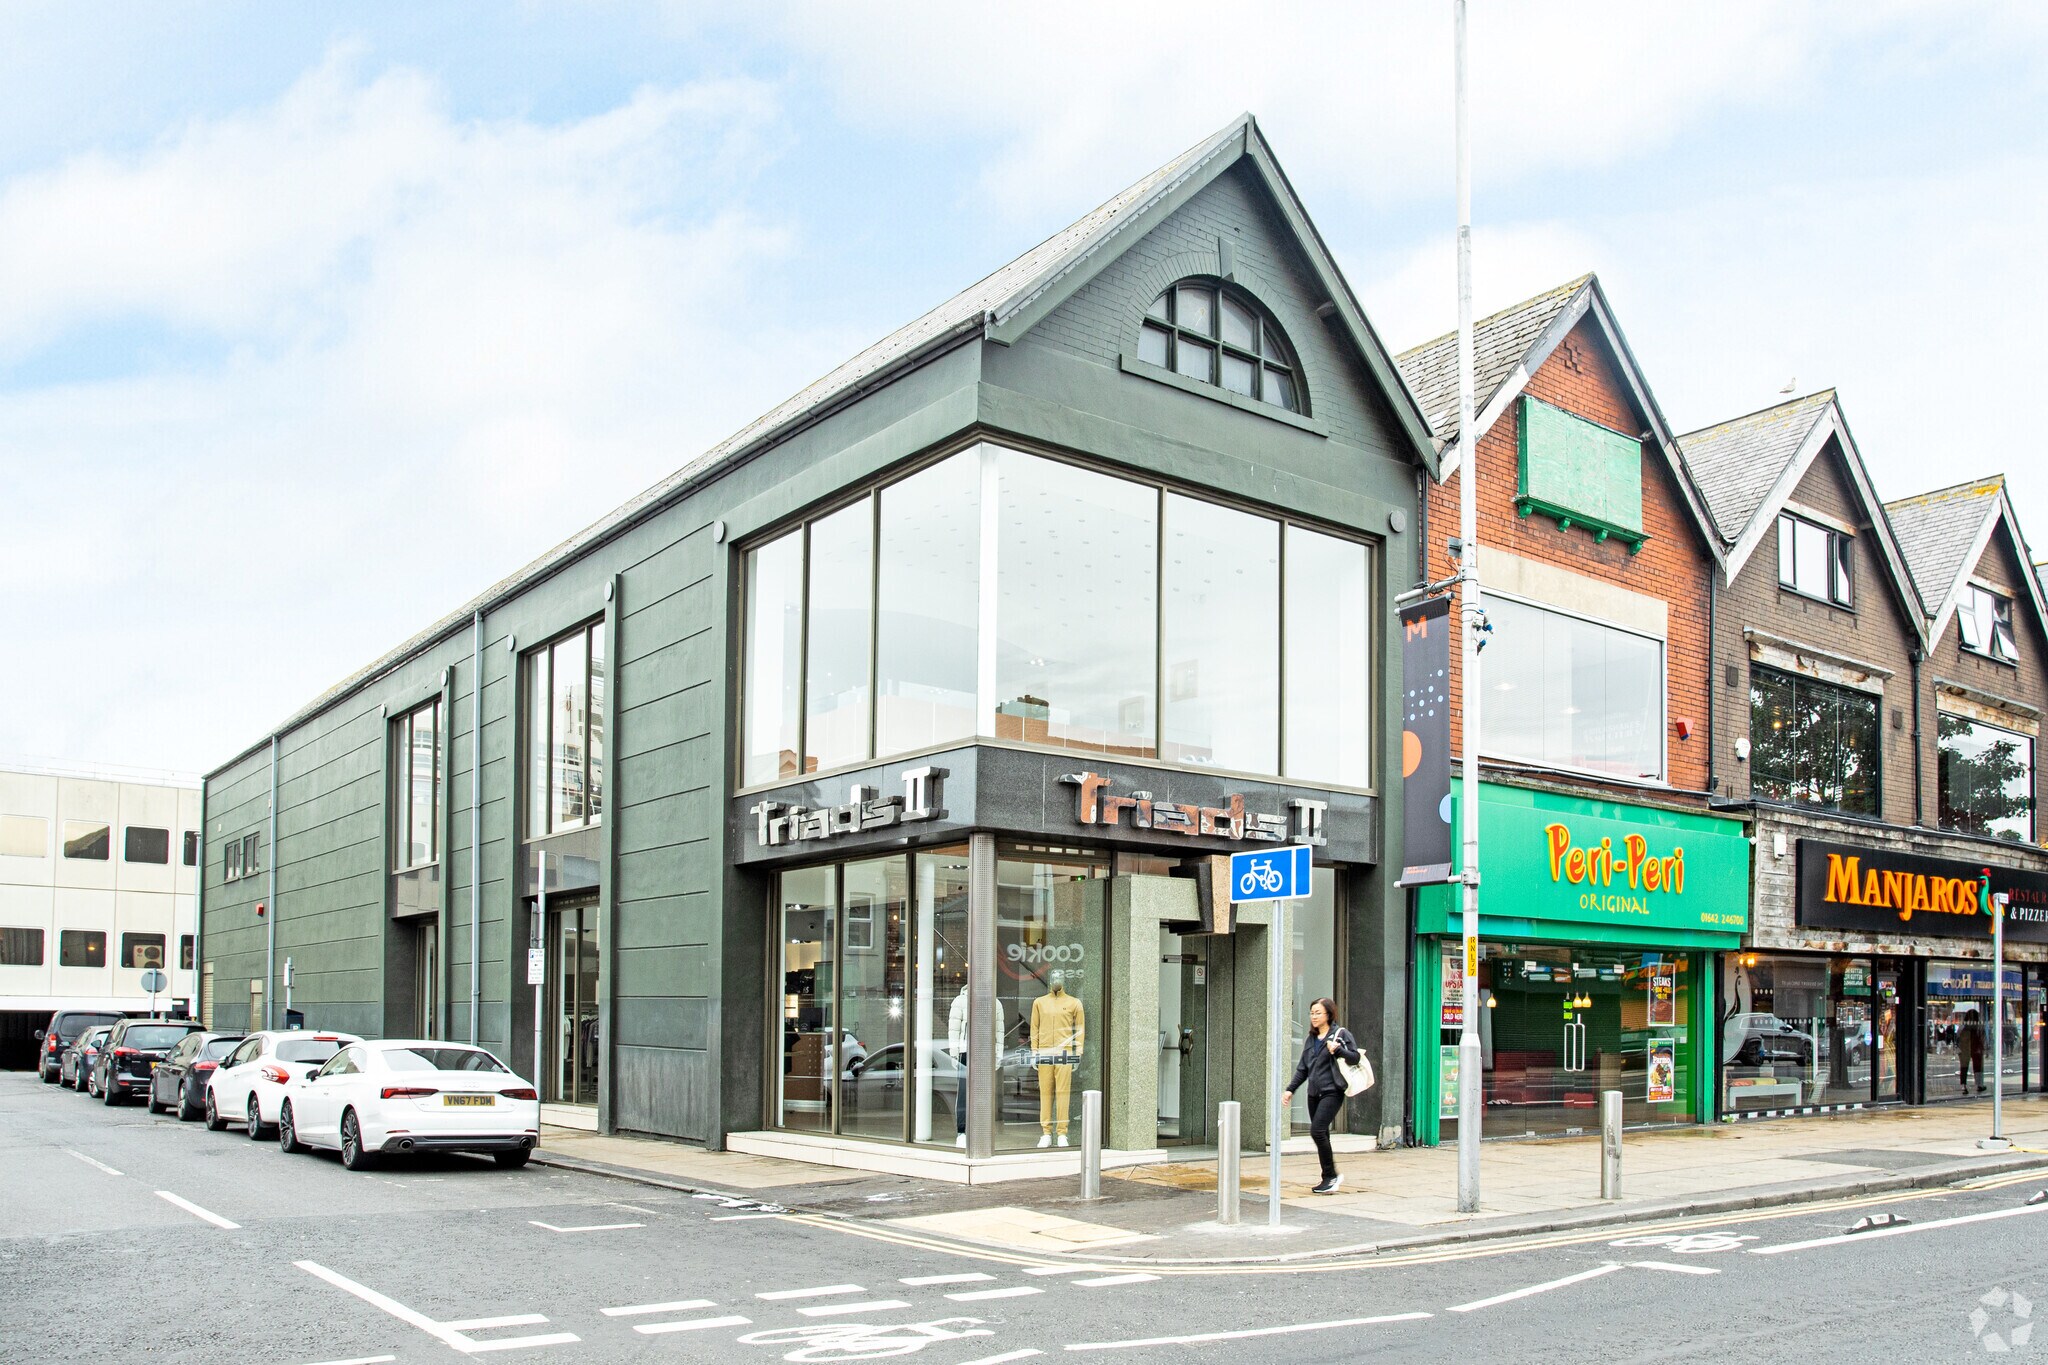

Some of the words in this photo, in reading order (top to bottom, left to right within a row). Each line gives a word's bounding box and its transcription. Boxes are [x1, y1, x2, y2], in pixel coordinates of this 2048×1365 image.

[1406, 614, 1428, 642] M
[750, 783, 902, 846] Triads
[900, 765, 950, 822] II
[1058, 771, 1288, 841] Triads
[1288, 798, 1328, 847] II
[1544, 823, 1685, 895] Peri-Peri
[1824, 853, 1978, 922] MANJAROS
[1579, 893, 1650, 915] ORIGINAL
[2010, 906, 2017, 920] &
[1700, 912, 1719, 924] 01642
[1015, 1049, 1081, 1065] Triads
[447, 1095, 471, 1105] VN67
